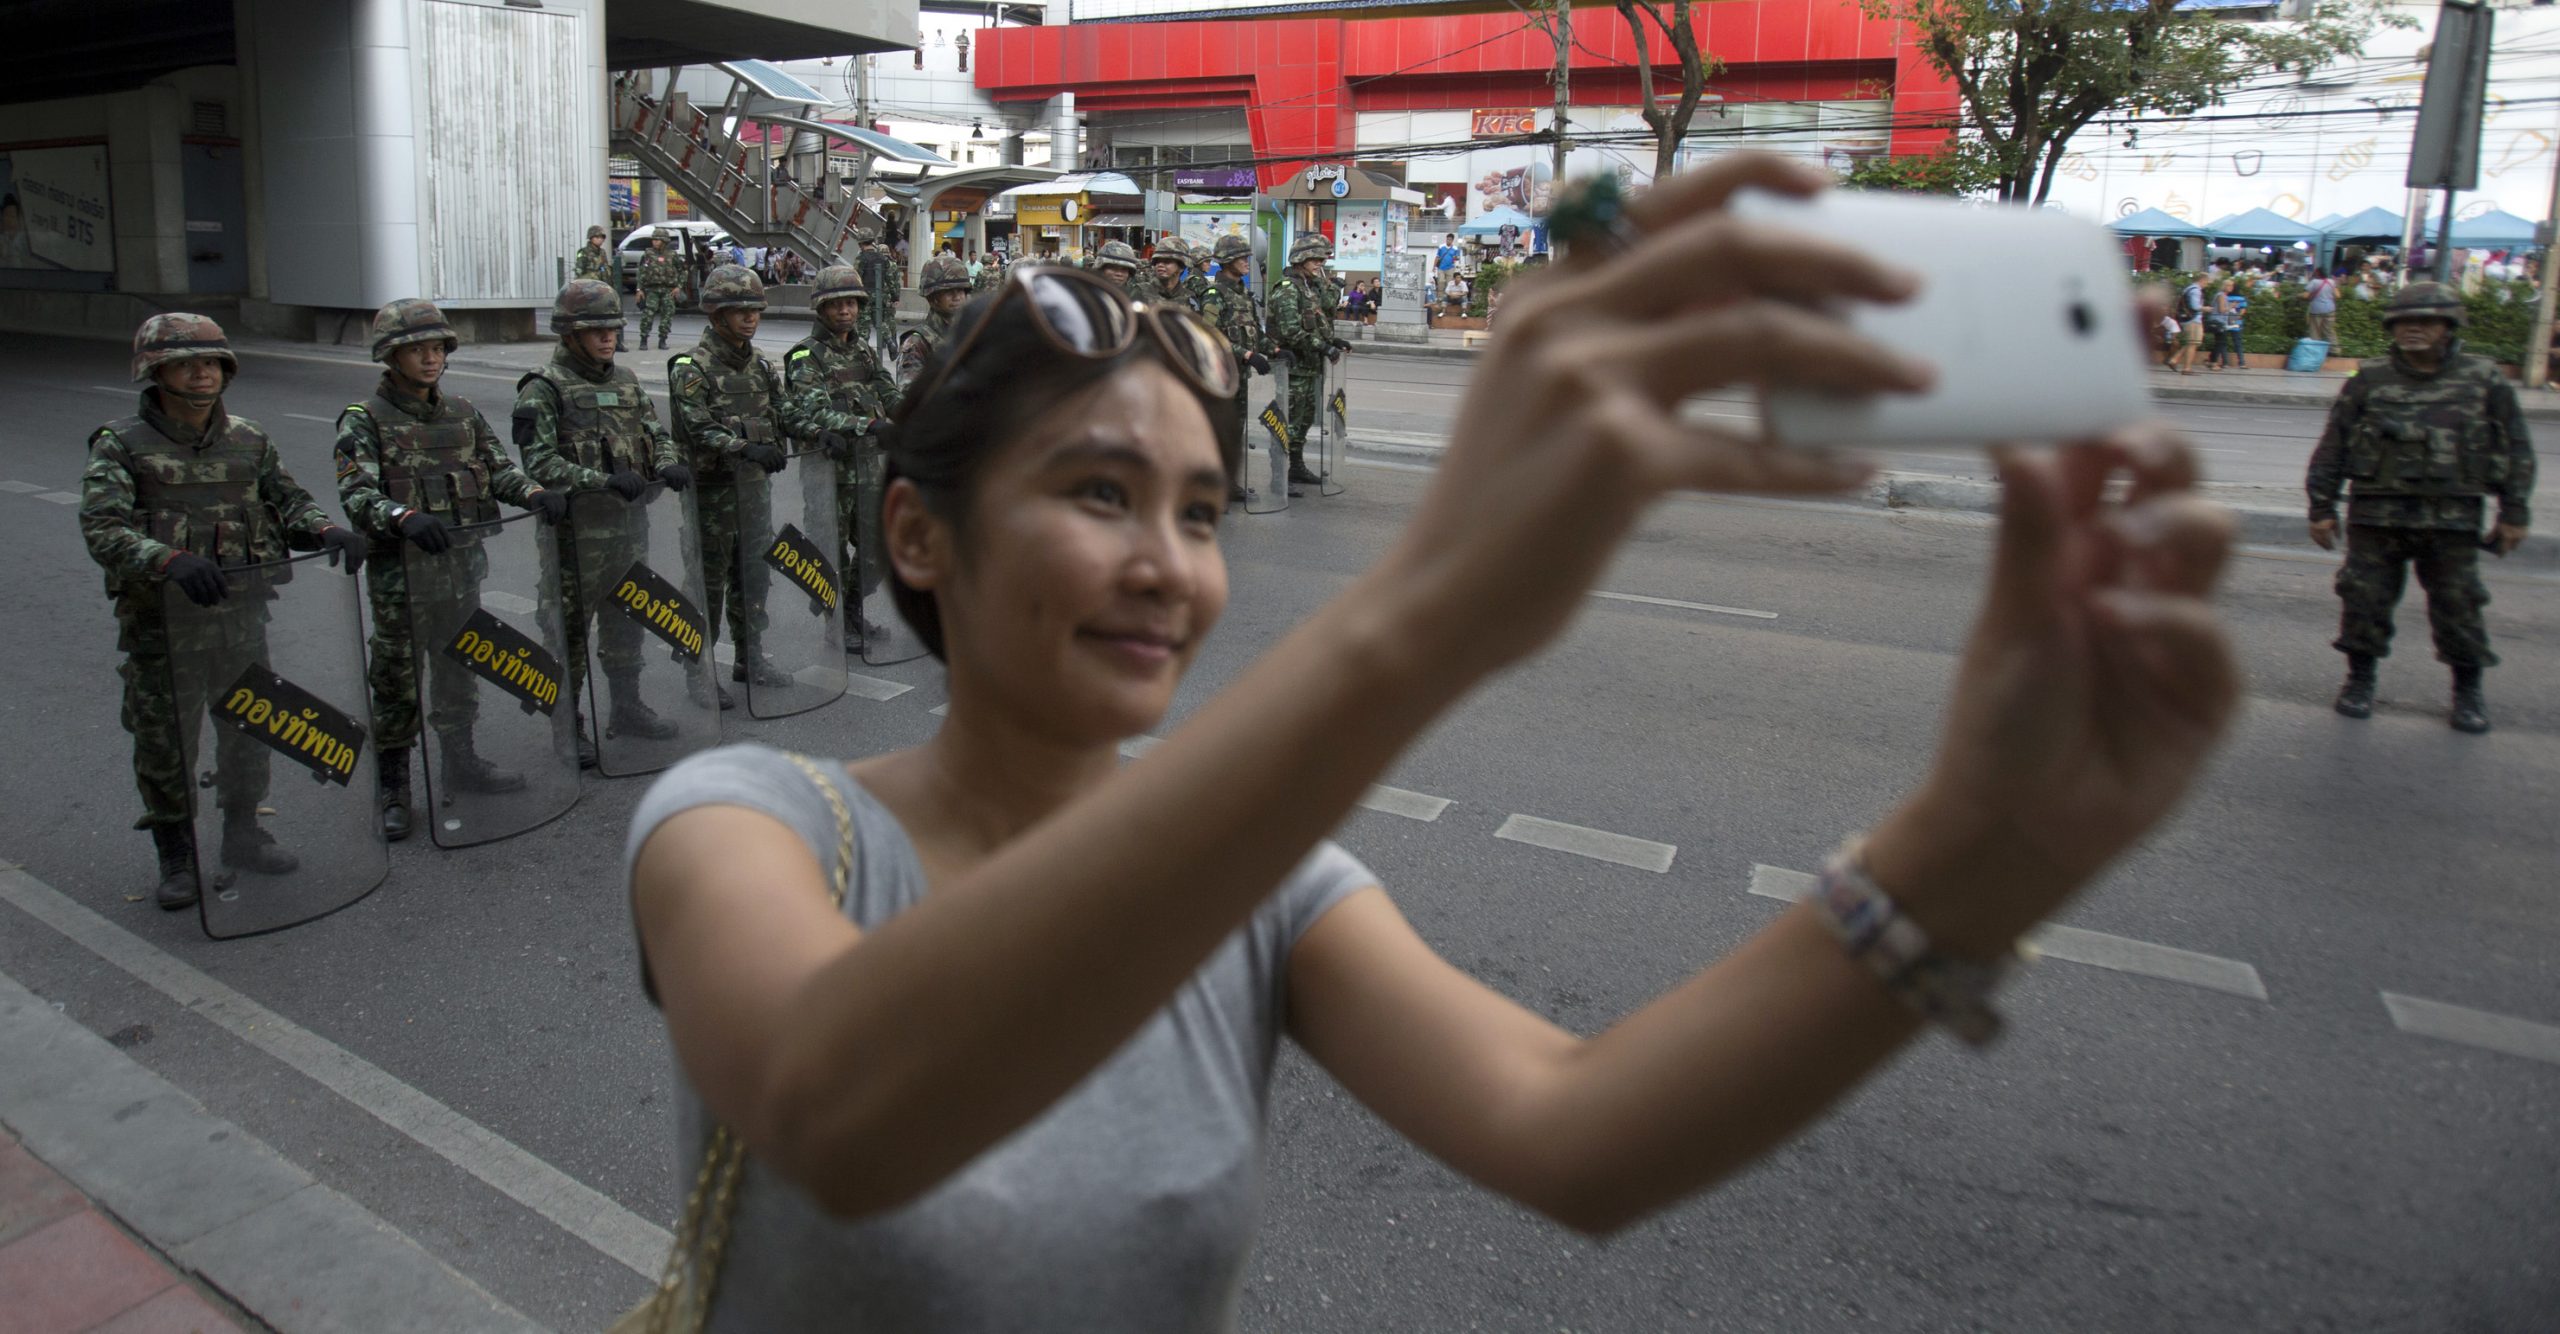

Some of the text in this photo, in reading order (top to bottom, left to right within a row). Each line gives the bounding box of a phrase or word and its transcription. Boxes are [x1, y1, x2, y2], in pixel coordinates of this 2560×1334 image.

[1474, 114, 1535, 134] KFC
[68, 215, 94, 246] BTS
[773, 541, 836, 608] กองทัพบก
[616, 580, 703, 655] กองทัพบก
[456, 631, 558, 705] กองทัพบก
[226, 688, 355, 774] กองทัพบก
